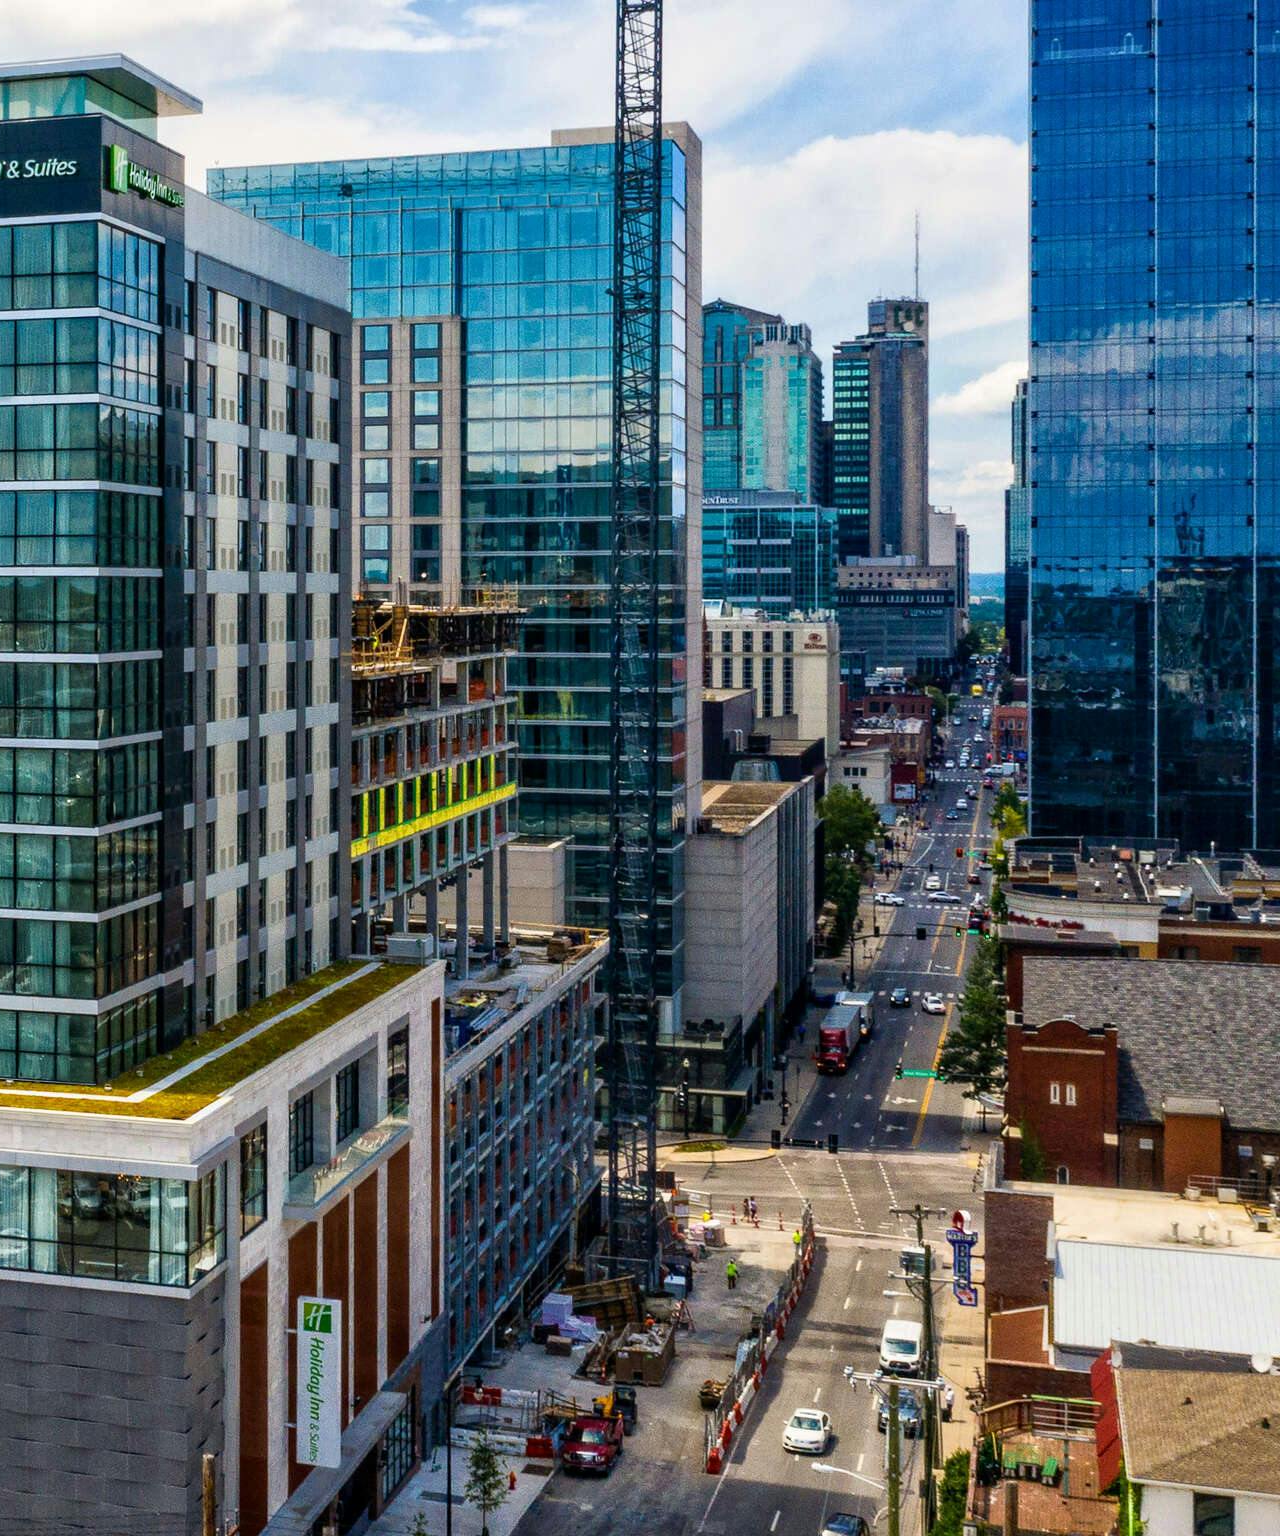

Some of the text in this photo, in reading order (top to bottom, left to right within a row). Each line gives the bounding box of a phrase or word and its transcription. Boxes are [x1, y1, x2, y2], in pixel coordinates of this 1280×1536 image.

[7, 160, 20, 178] &
[23, 157, 77, 178] Suites
[129, 162, 157, 200] Holiday
[156, 174, 168, 199] Inn
[307, 1337, 325, 1463] Holiday Inn & Suites
